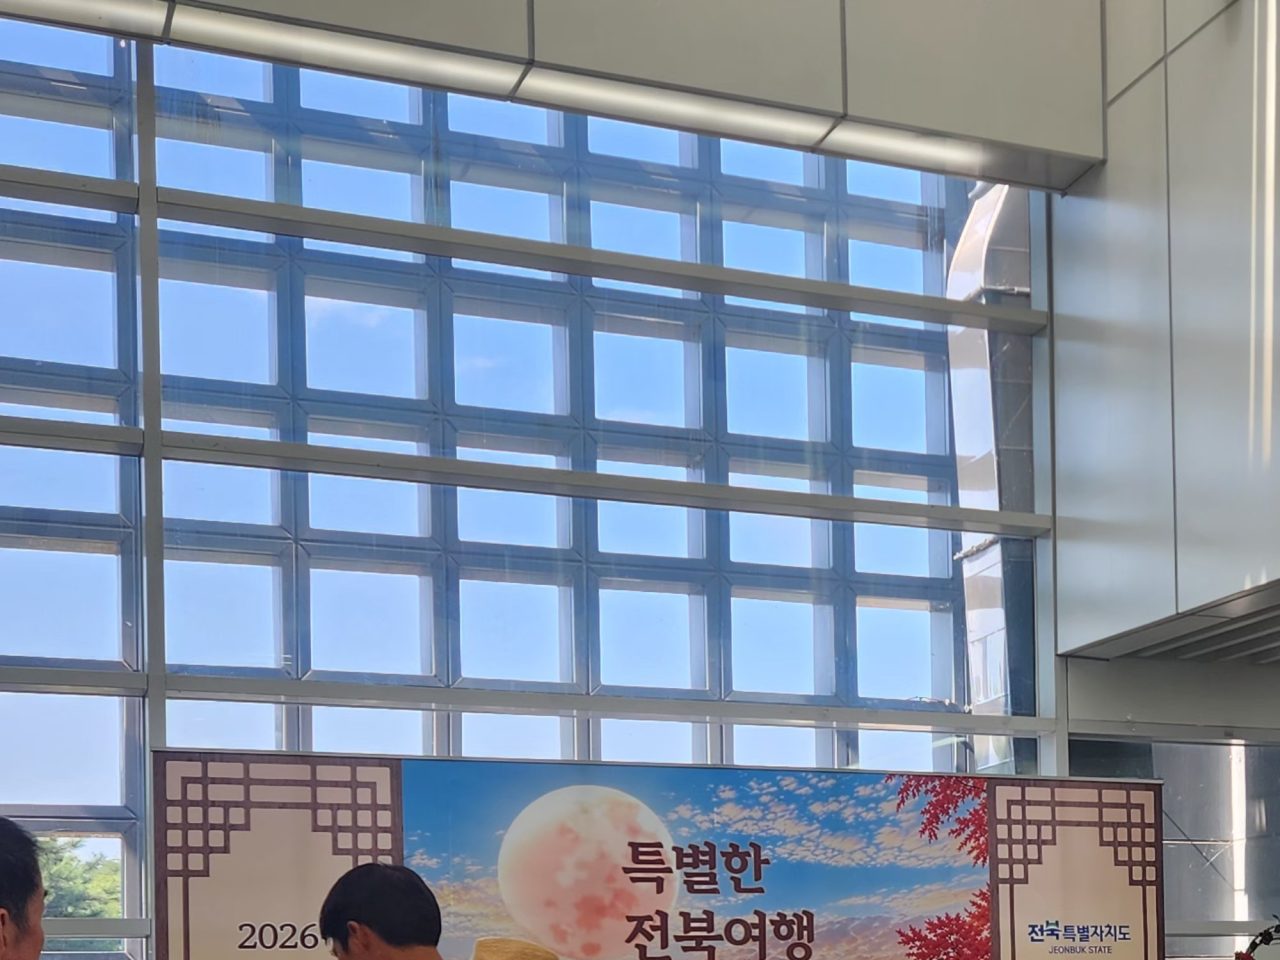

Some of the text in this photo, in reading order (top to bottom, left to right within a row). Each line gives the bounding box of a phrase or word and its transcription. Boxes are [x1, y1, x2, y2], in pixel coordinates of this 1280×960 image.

[621, 840, 771, 895] 특별한
[237, 923, 319, 949] 2026
[1027, 920, 1131, 942] 전북특별자치도
[1048, 944, 1113, 955] JEONBUK STATE
